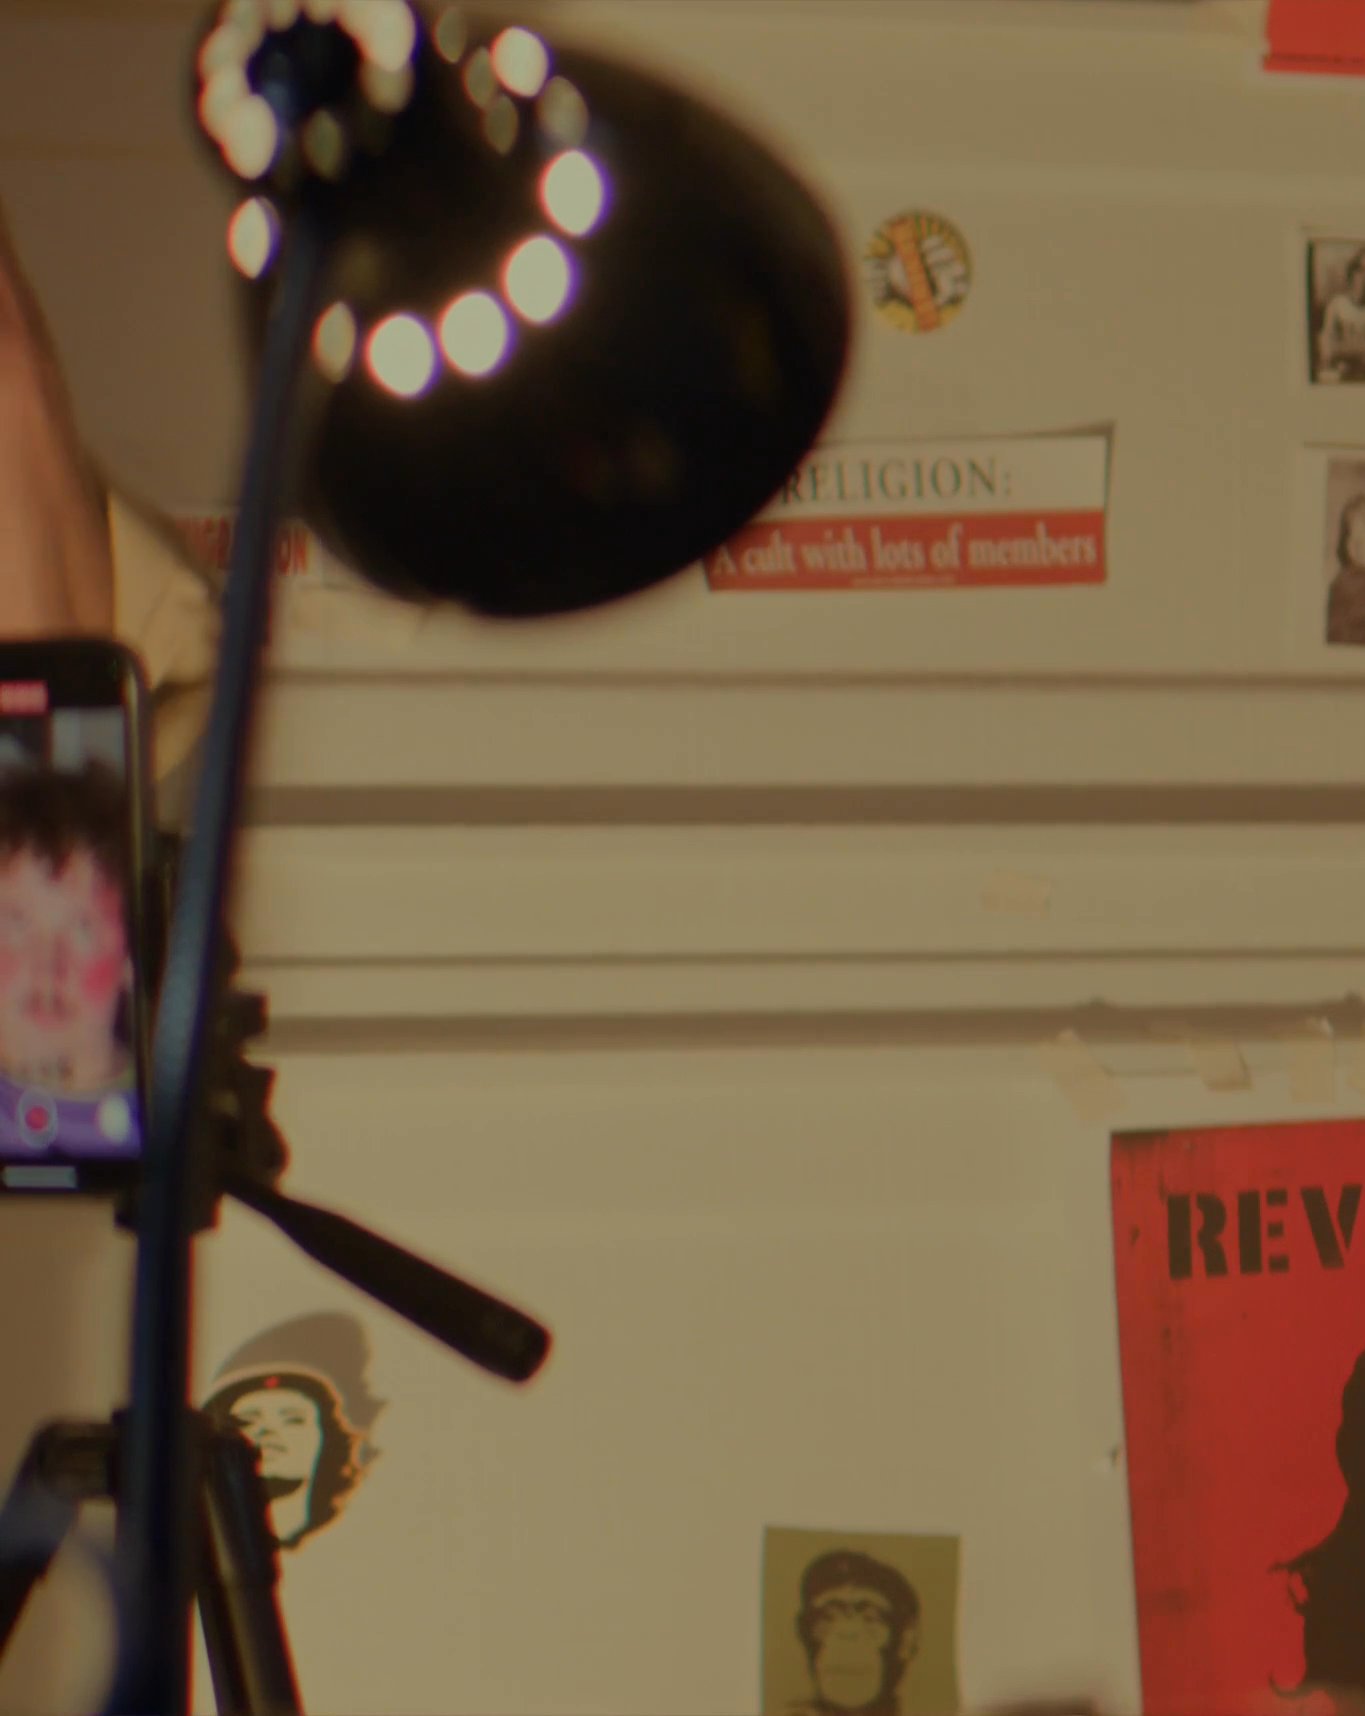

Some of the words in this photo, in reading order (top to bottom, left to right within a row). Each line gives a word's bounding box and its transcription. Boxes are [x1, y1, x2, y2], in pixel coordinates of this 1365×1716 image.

[711, 546, 736, 576] A
[743, 529, 798, 573] cult
[801, 525, 867, 573] with
[871, 526, 926, 571] lots
[930, 523, 963, 567] of
[967, 520, 1097, 569] members
